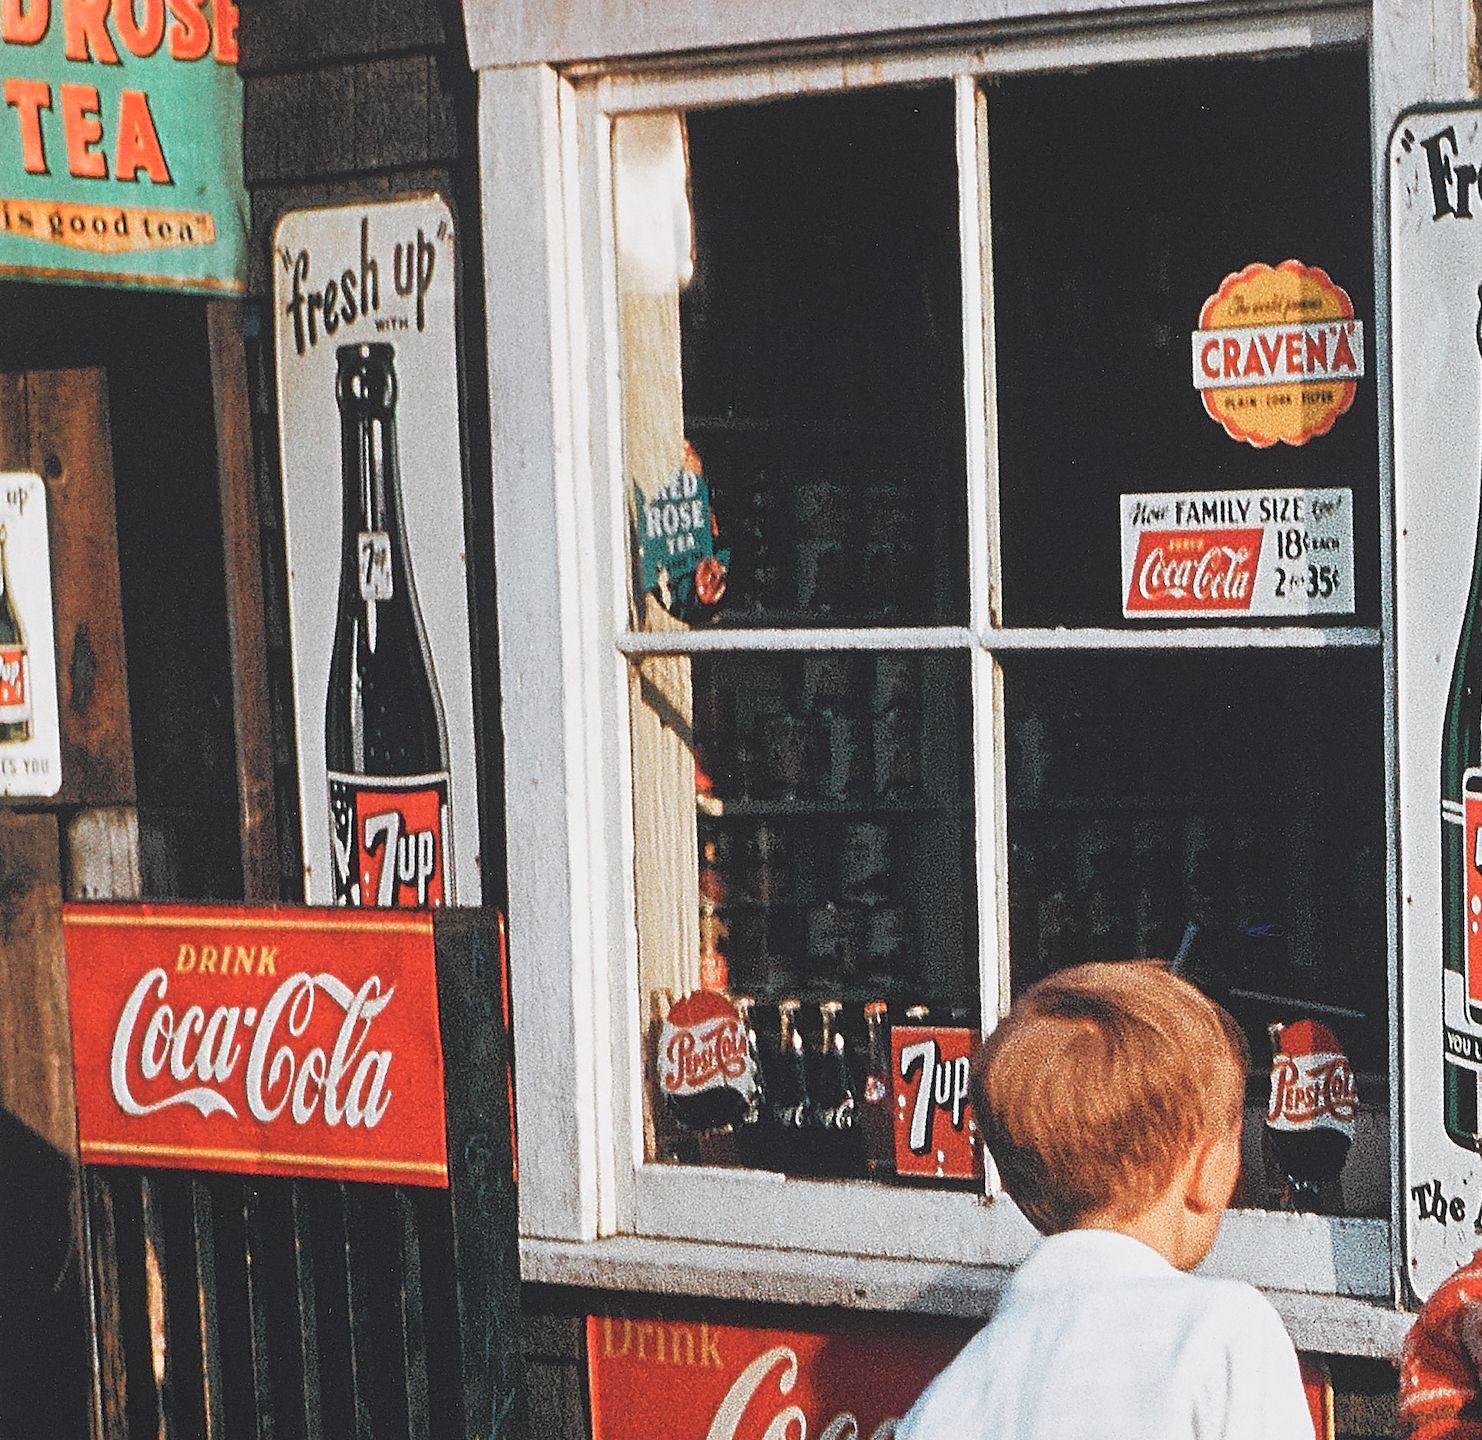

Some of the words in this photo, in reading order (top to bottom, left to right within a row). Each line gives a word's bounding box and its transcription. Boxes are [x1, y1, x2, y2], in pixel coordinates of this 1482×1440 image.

[4, 79, 174, 185] TEA
[49, 206, 129, 237] good
[281, 216, 379, 358] "fresh
[374, 316, 409, 334] WITH
[648, 501, 704, 538] ROSE
[1175, 499, 1251, 526] FAMILY
[1259, 496, 1304, 523] SIZE
[1139, 547, 1251, 601] Coca-Cola
[1275, 567, 1286, 598] 2
[176, 943, 278, 977] DRINK
[110, 966, 395, 1130] Coca-Cola
[1448, 1032, 1472, 1052] YOU
[1411, 1178, 1467, 1227] The
